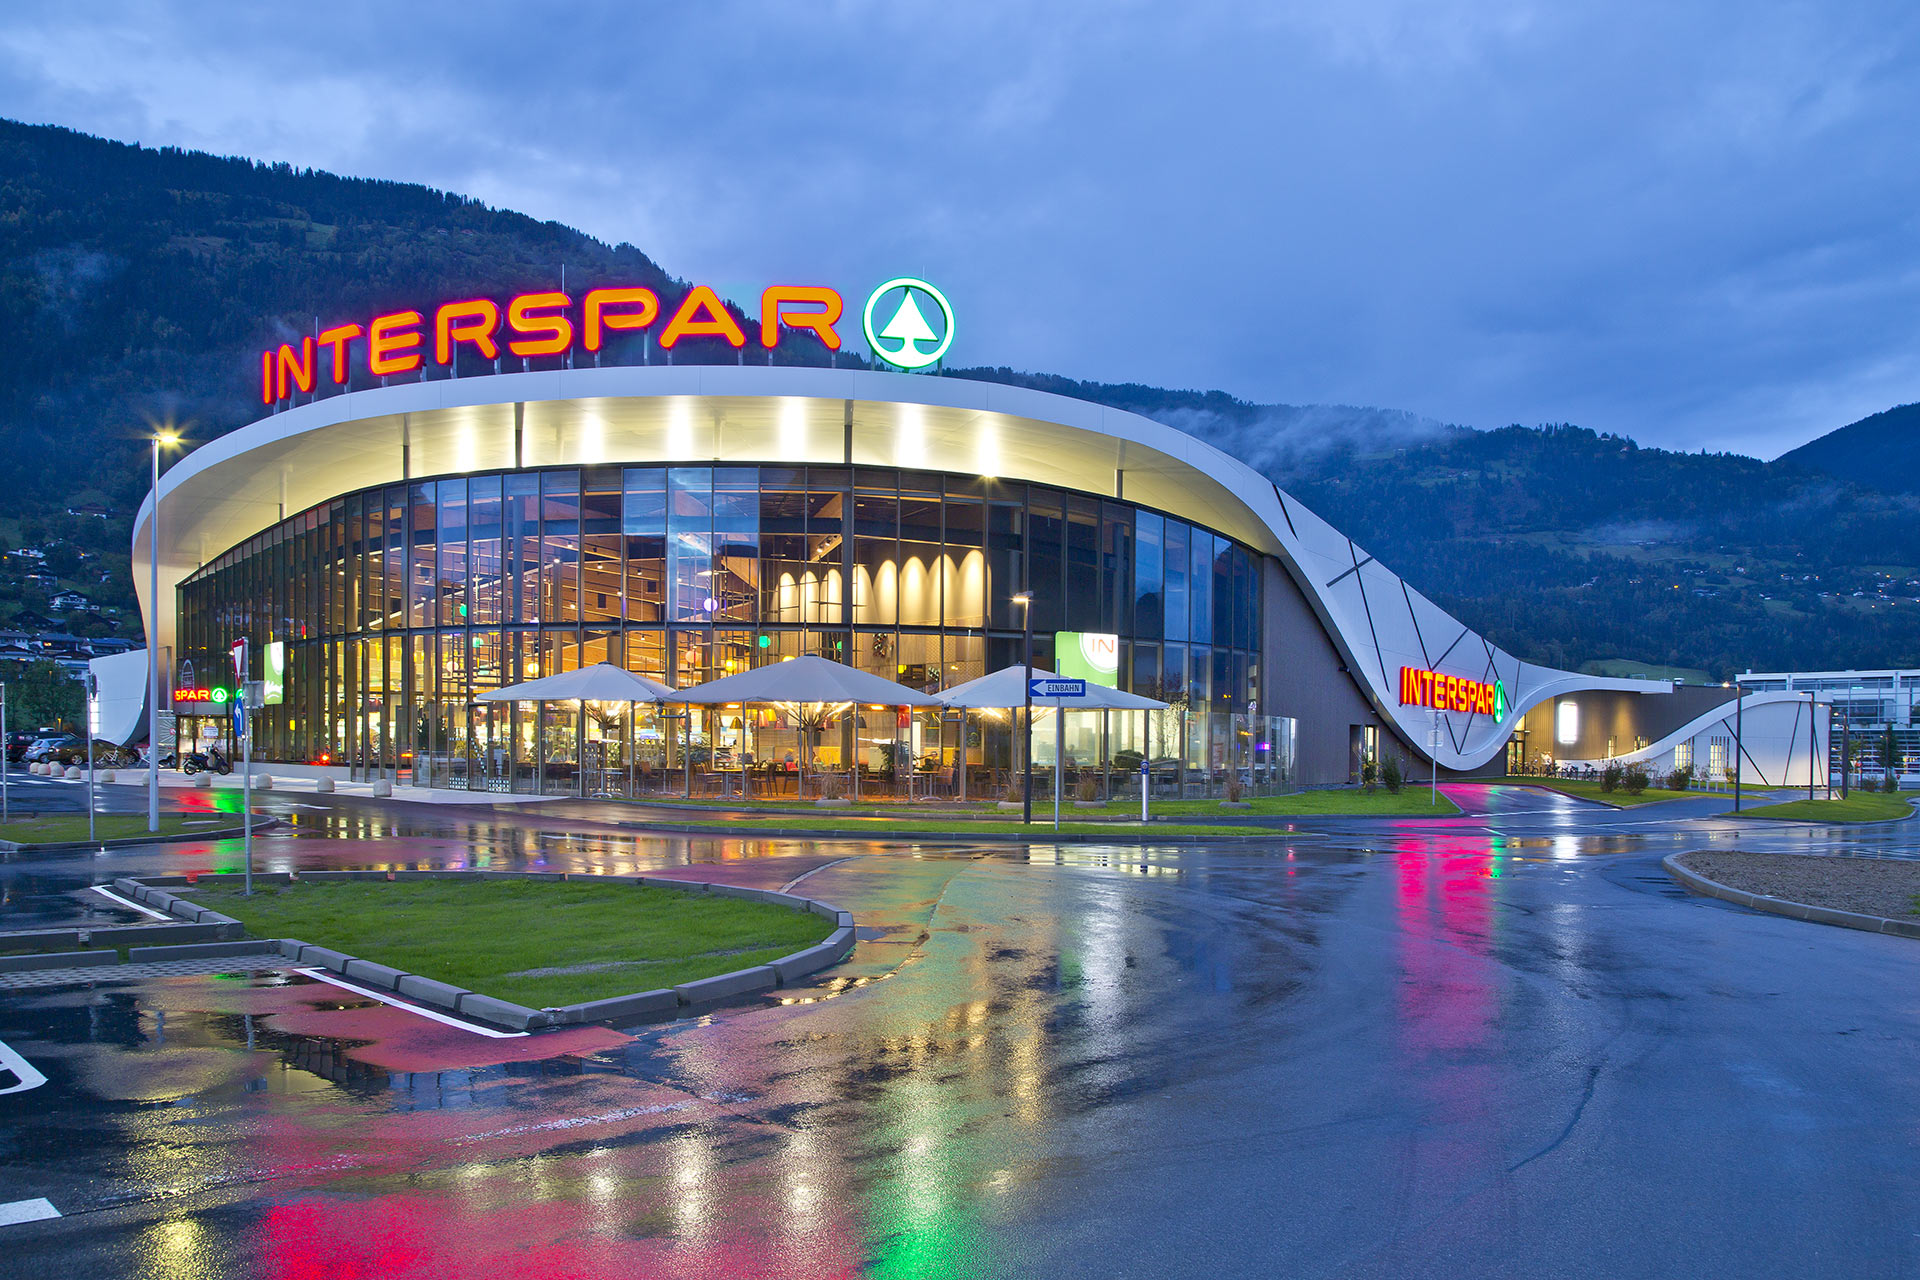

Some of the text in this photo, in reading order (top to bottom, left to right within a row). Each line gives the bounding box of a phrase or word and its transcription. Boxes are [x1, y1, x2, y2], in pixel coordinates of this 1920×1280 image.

[262, 285, 844, 405] INTERSPAR
[1091, 638, 1115, 653] IN
[174, 689, 210, 701] SPAR
[1047, 684, 1080, 692] EINBAHN
[1401, 665, 1495, 716] INTERSPAR
